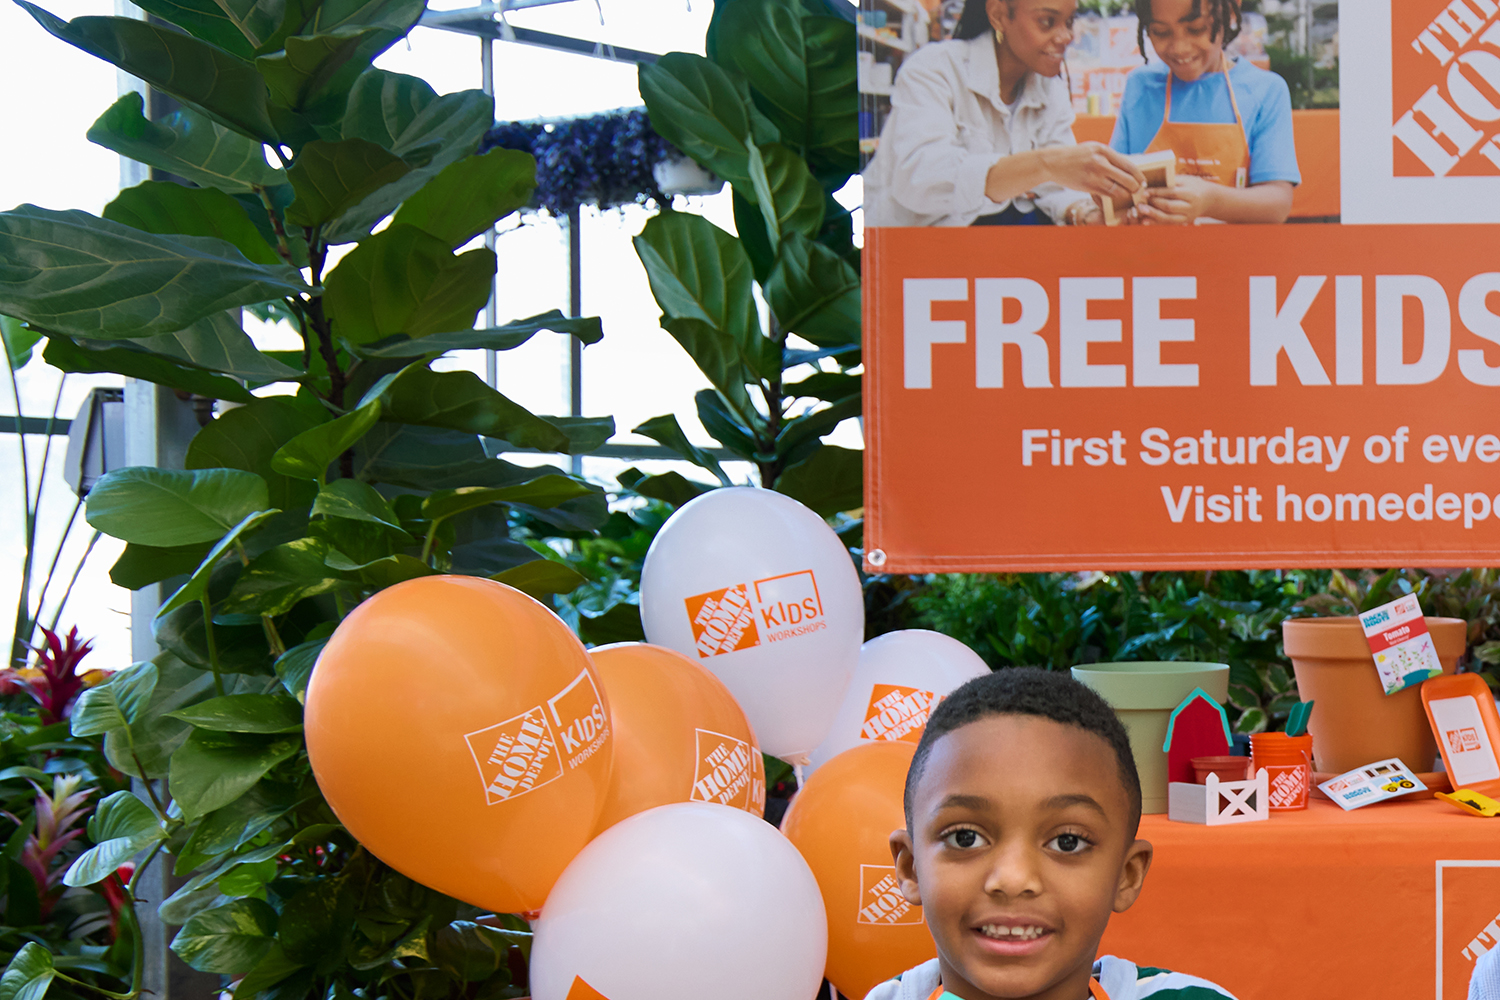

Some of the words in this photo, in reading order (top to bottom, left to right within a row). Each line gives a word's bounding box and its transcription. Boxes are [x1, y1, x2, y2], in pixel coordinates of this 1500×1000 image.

[902, 276, 1200, 389] FREE
[1021, 429, 1127, 467] First
[1139, 427, 1350, 471] Saturday
[1363, 426, 1410, 464] of
[1161, 485, 1262, 523] Visit
[694, 597, 718, 625] THE
[697, 585, 750, 656] HOME
[720, 606, 754, 652] DEPOT
[761, 598, 817, 629] KIDS
[766, 620, 827, 643] WORKSHOPS
[1383, 625, 1411, 642] Tomato
[862, 689, 933, 740] HOME
[873, 689, 905, 712] THE
[560, 703, 604, 754] KIDS
[568, 725, 610, 769] WORKSHOPS
[486, 713, 547, 799] HOME
[487, 733, 515, 766] THE
[519, 736, 554, 790] DEPOT
[704, 743, 730, 768] THE
[695, 741, 750, 802] HOME
[1268, 766, 1305, 808] HOME
[1271, 771, 1288, 787] THE
[1282, 780, 1305, 809] DEPOT
[860, 886, 905, 922] HOM
[868, 873, 897, 898] THE
[885, 901, 911, 924] DEP
